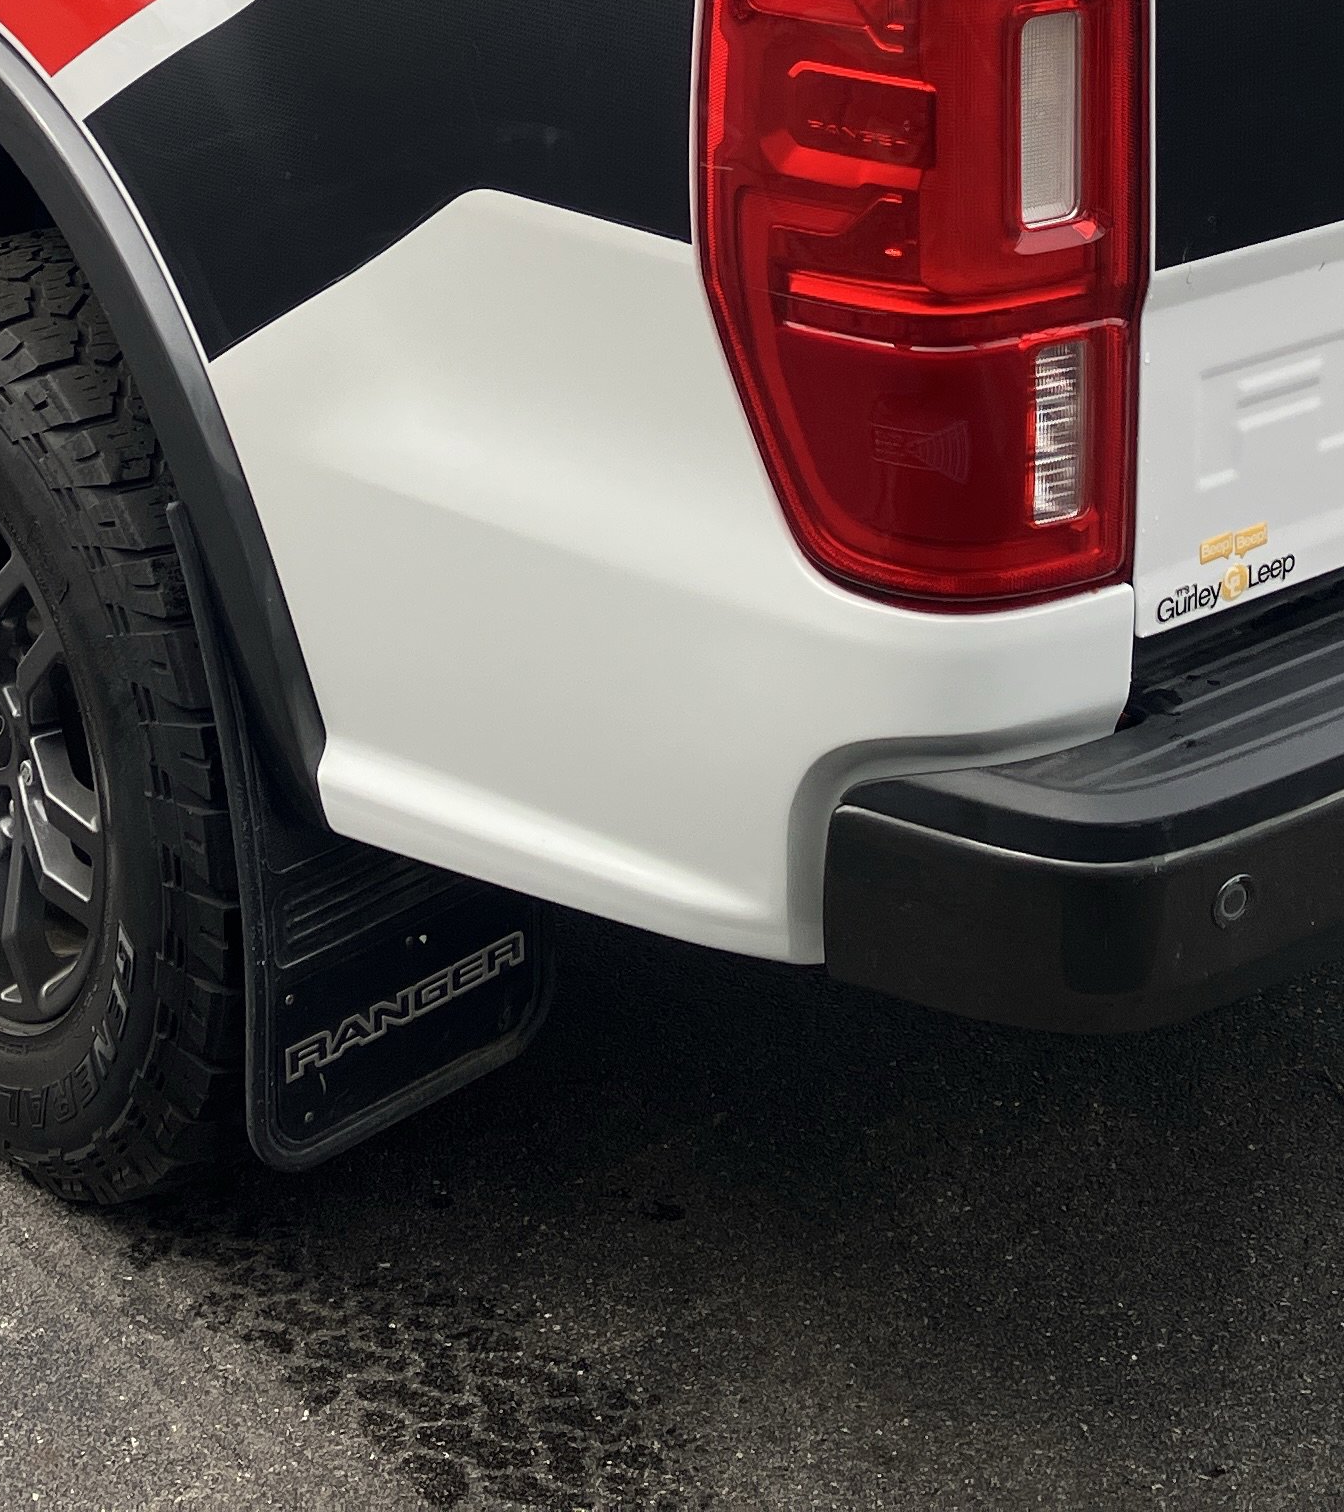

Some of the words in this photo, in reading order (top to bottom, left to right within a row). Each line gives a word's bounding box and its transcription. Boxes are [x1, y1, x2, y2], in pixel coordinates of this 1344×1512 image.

[1157, 581, 1222, 623] Gurley
[1248, 553, 1296, 588] Leep
[285, 930, 525, 1084] RANGER
